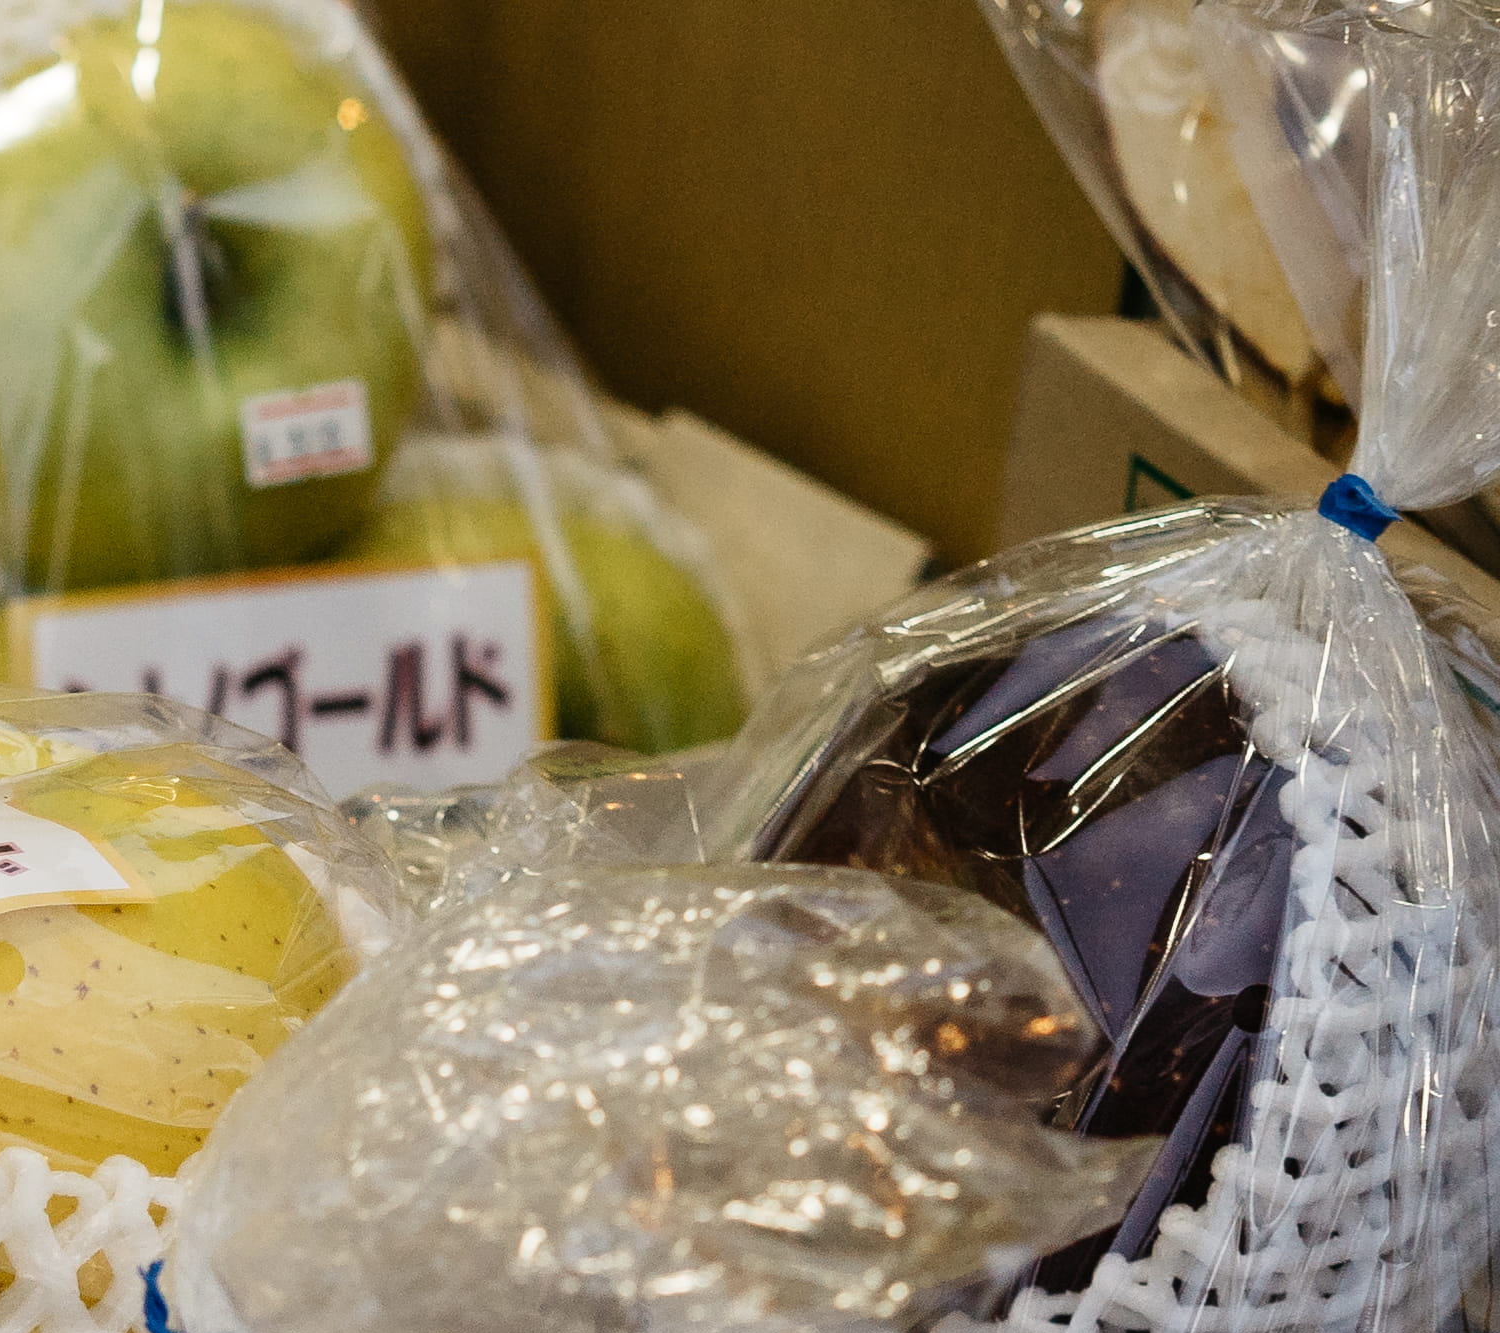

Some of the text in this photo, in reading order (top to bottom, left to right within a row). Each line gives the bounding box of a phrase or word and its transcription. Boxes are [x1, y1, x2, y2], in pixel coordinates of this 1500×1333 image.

[61, 629, 511, 758] ノゴールド
